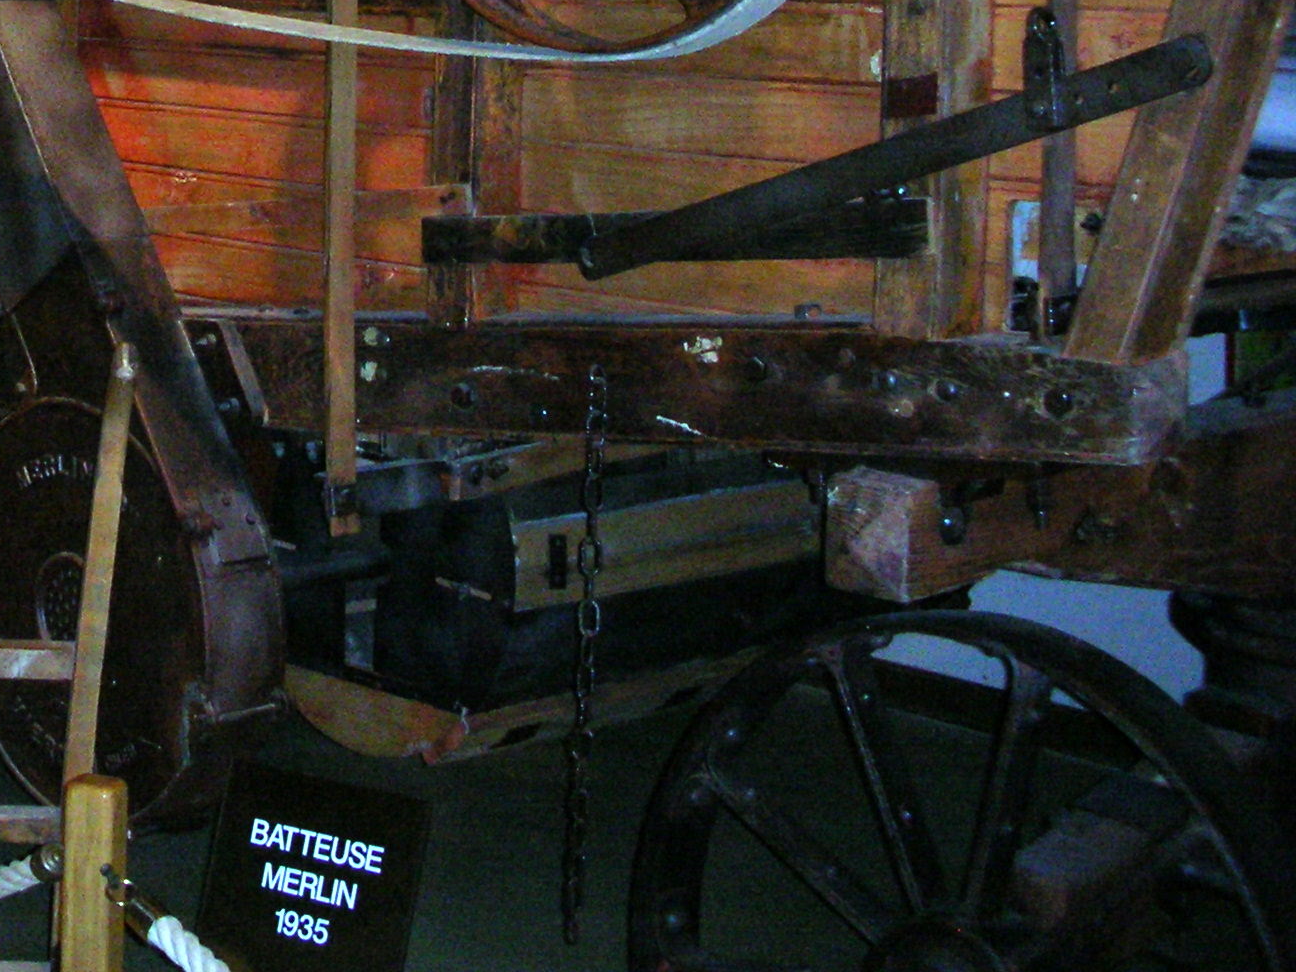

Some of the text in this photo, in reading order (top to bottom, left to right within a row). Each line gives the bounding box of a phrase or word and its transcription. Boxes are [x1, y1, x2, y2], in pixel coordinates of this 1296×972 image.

[250, 817, 386, 874] BATTEUSE
[260, 861, 359, 910] MERLIN
[274, 908, 331, 945] 1935
